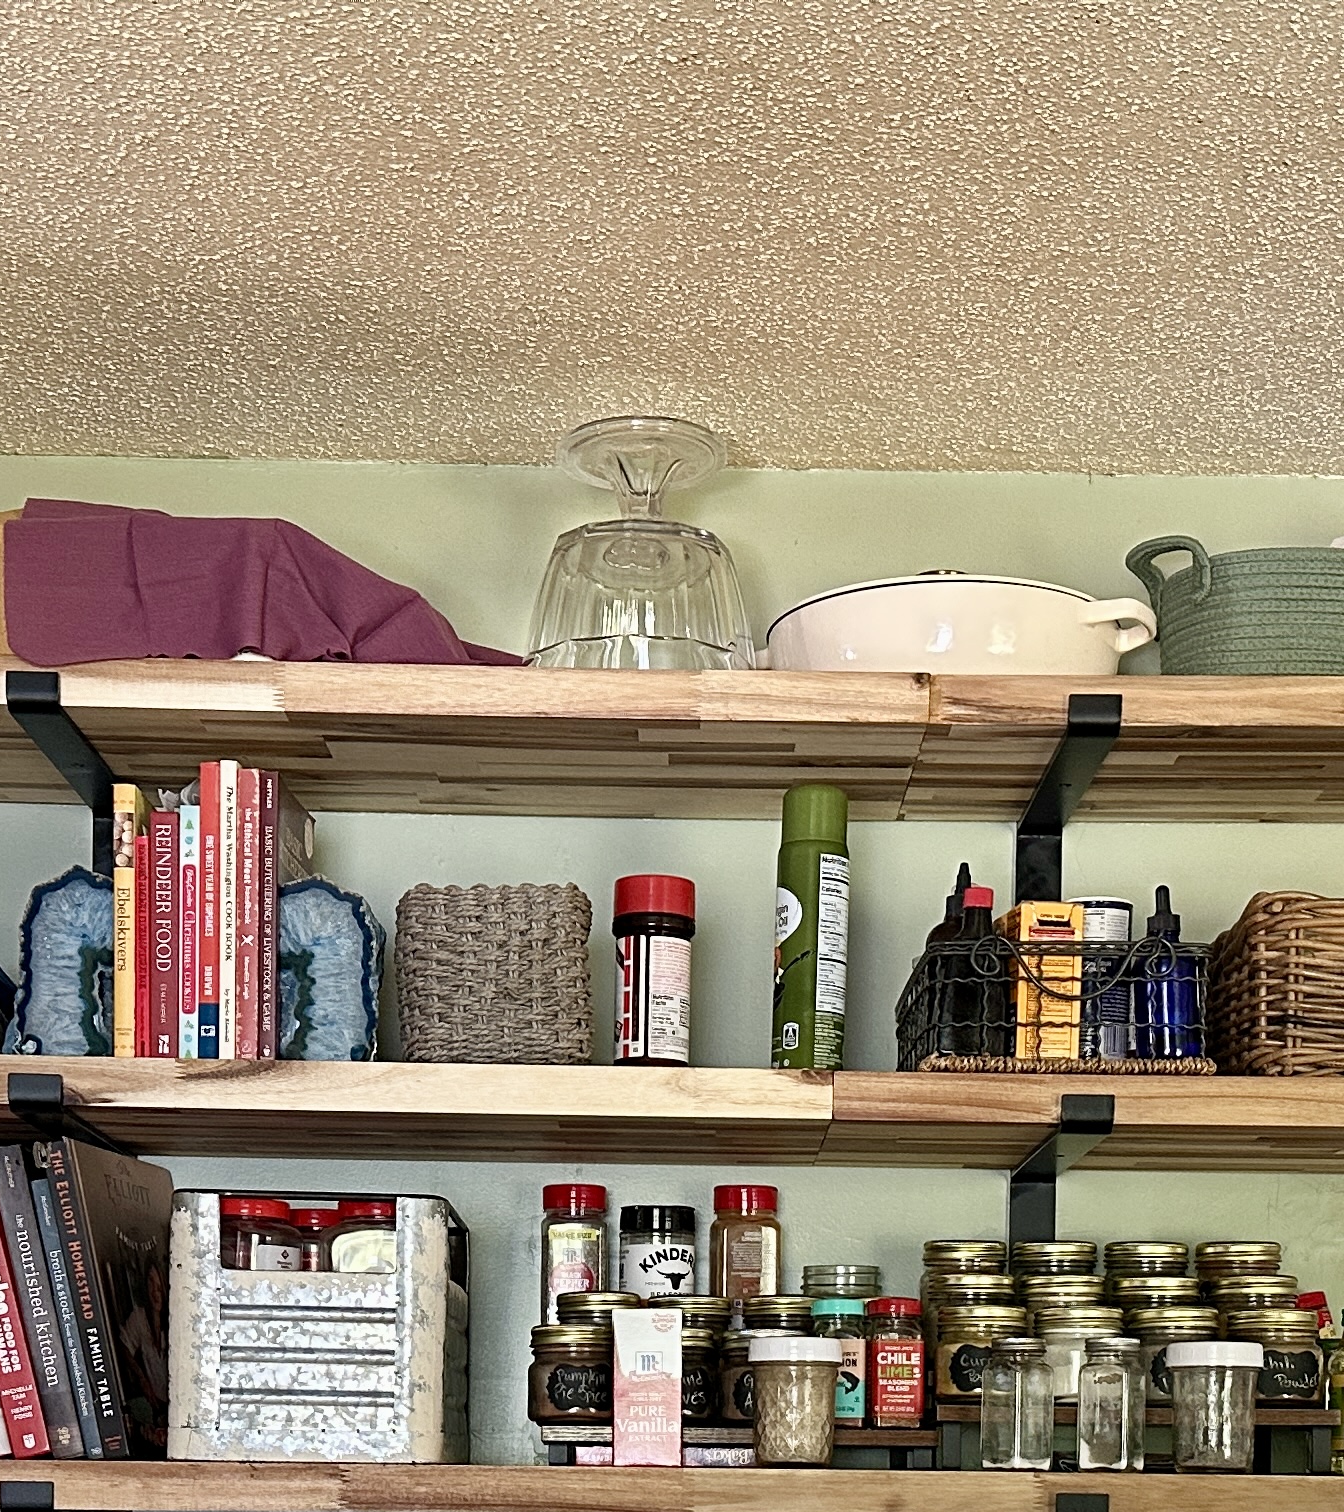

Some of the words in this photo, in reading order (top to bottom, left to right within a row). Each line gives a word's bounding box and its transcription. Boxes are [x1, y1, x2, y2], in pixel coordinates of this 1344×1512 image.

[225, 806, 233, 840] Martha
[244, 822, 253, 856] Ethical
[264, 826, 273, 855] BASIC
[155, 824, 172, 913] REINDEER
[224, 843, 233, 898] Washington
[243, 858, 253, 883] Meat
[263, 857, 273, 921] BUTCHERING
[116, 887, 130, 972] Ebelskivers
[155, 919, 172, 972] FOOD
[183, 911, 195, 968] Christmas
[263, 924, 272, 935] OF
[262, 937, 272, 991] LIVESTOCK
[262, 1002, 271, 1031] GAME
[49, 1150, 66, 1176] THE
[14, 1213, 26, 1229] the
[55, 1179, 79, 1236] ELLIOTT
[14, 1228, 50, 1318] nourished
[48, 1249, 68, 1282] broth
[67, 1240, 95, 1321] HOMESTEAD
[554, 1279, 590, 1288] PEPPER
[56, 1290, 75, 1322] stock
[1, 1316, 17, 1348] FOOD
[8, 1350, 22, 1372] FOR
[34, 1321, 65, 1388] kitchen
[86, 1326, 107, 1374] FAMILY
[877, 1352, 920, 1364] CHILE
[878, 1366, 912, 1378] LIME
[95, 1377, 115, 1418] TABLE
[630, 1406, 666, 1416] PURE
[616, 1418, 680, 1433] Vanilla
[628, 1434, 667, 1442] EXTRACT
